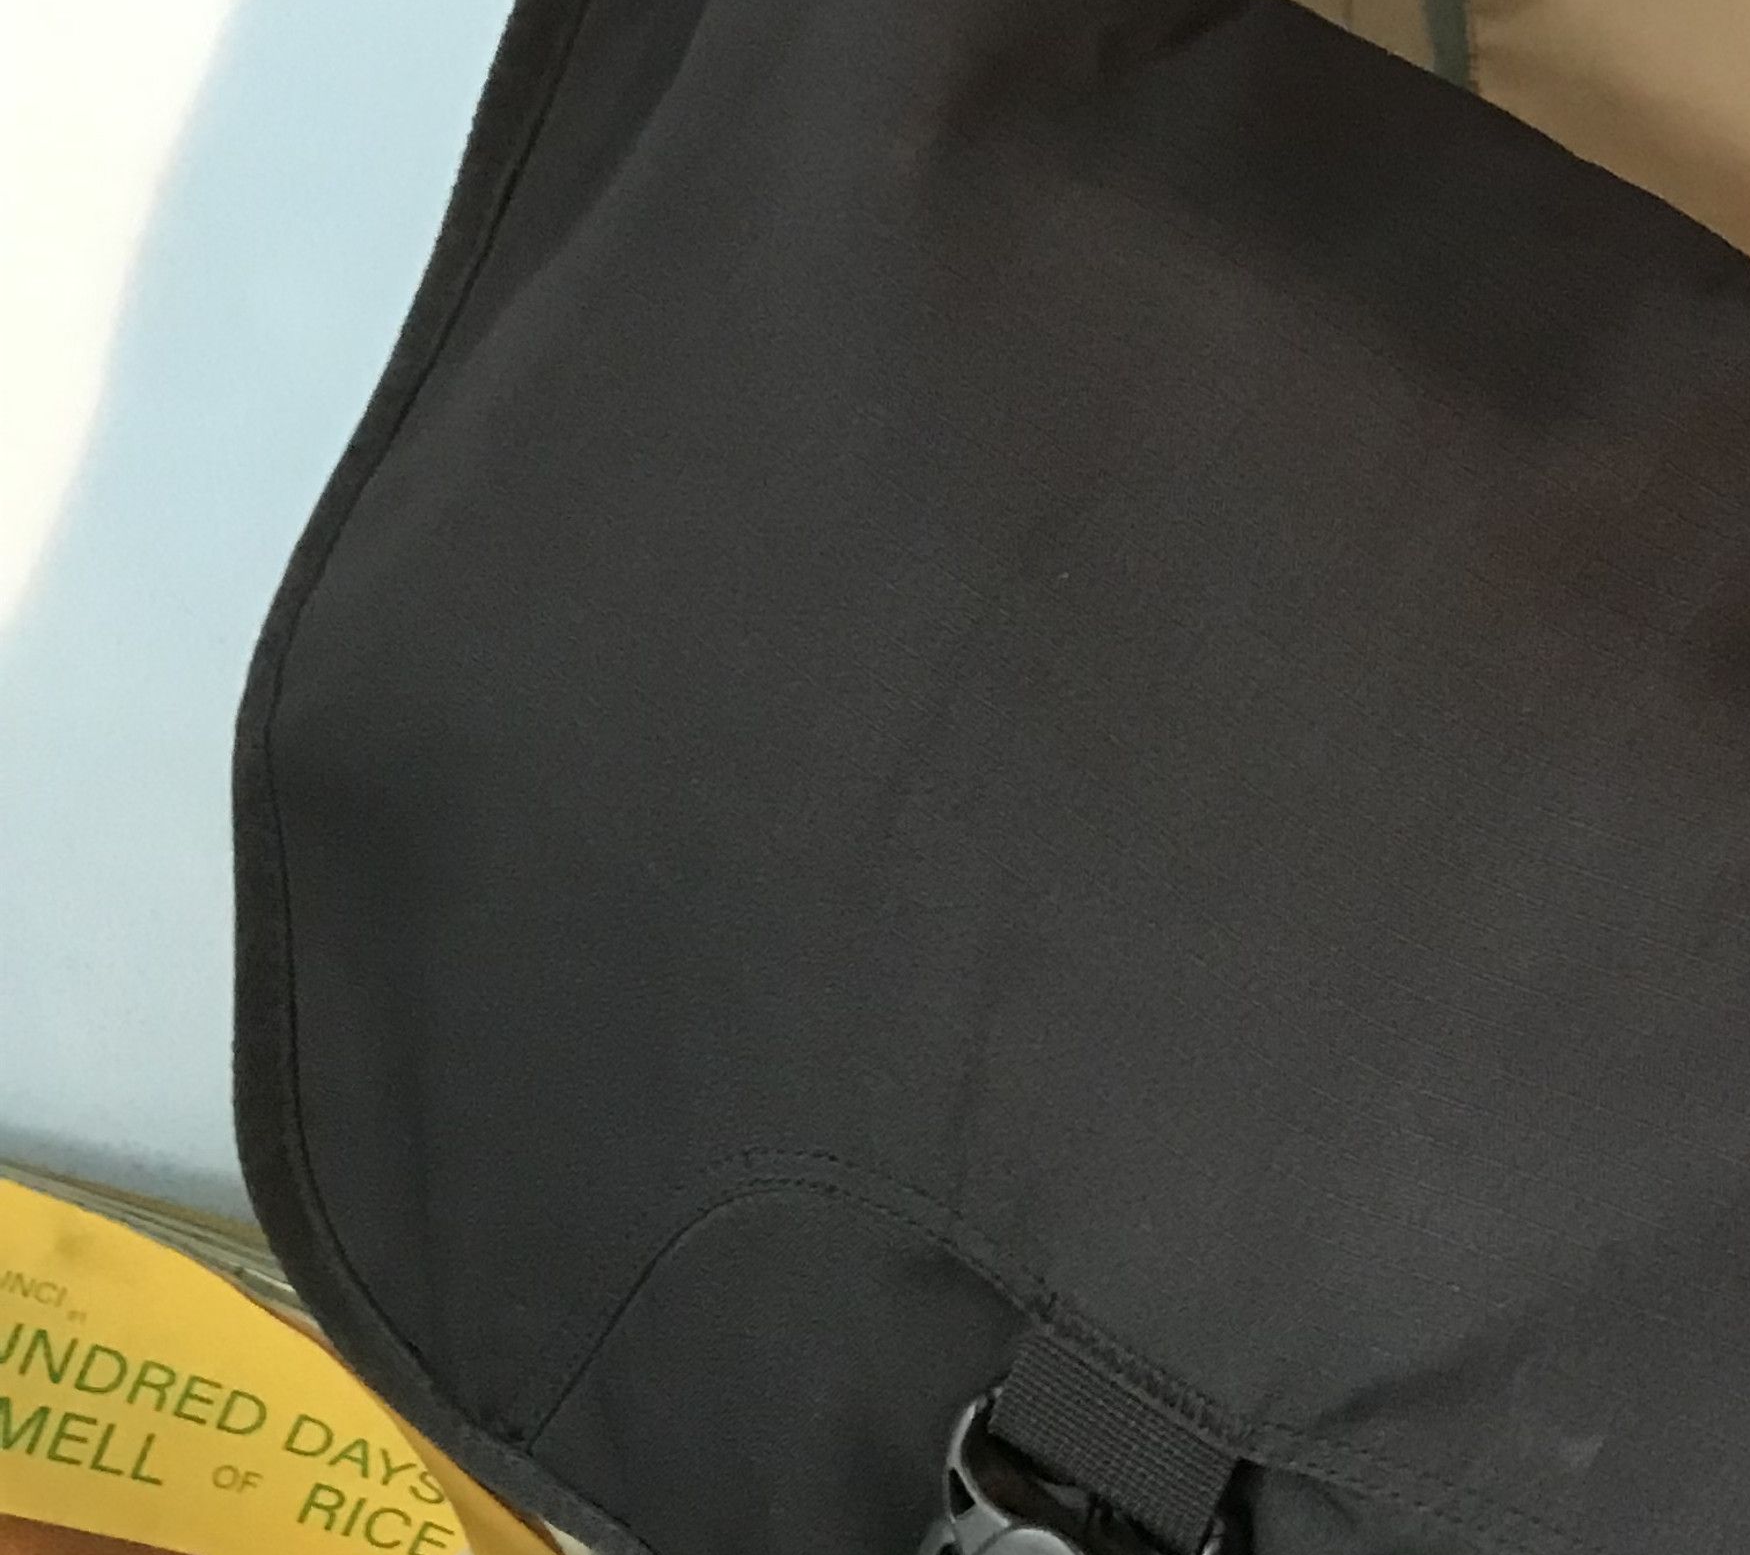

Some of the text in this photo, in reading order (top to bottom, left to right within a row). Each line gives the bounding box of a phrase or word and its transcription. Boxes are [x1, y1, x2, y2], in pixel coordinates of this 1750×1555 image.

[0, 1396, 163, 1486] MELL
[211, 1464, 263, 1492] OF
[282, 1413, 446, 1505] DAYS
